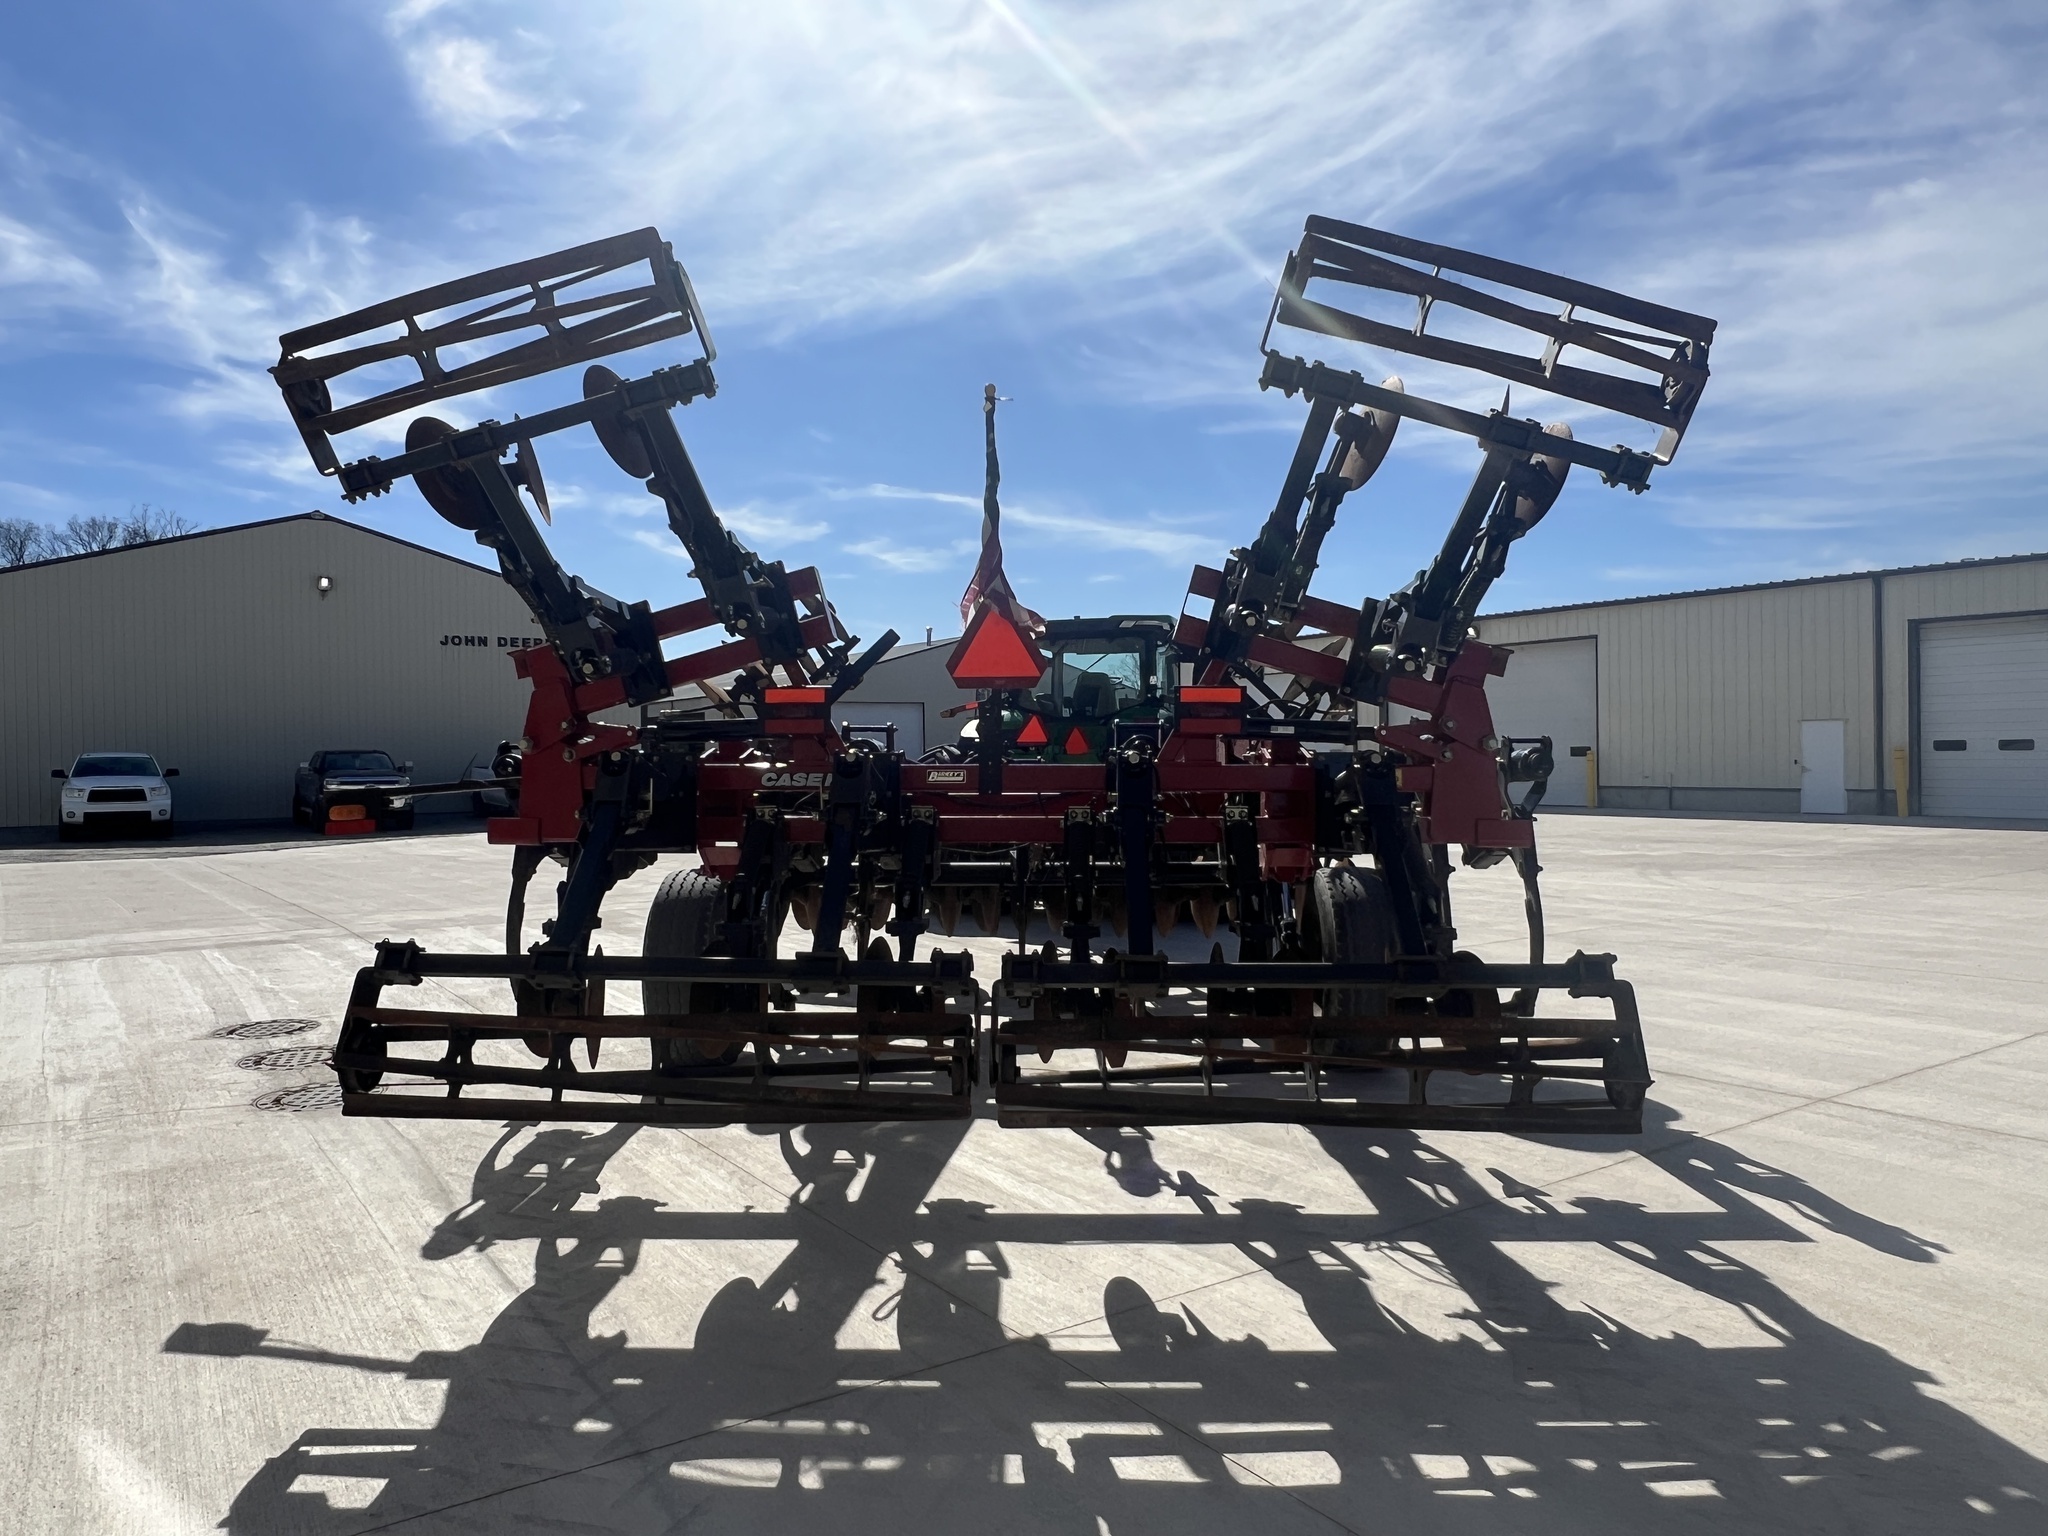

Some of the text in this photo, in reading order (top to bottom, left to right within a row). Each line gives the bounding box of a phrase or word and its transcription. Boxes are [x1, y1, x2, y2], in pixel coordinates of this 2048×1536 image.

[440, 635, 548, 648] JOHN DEER
[761, 772, 824, 787] CASE
